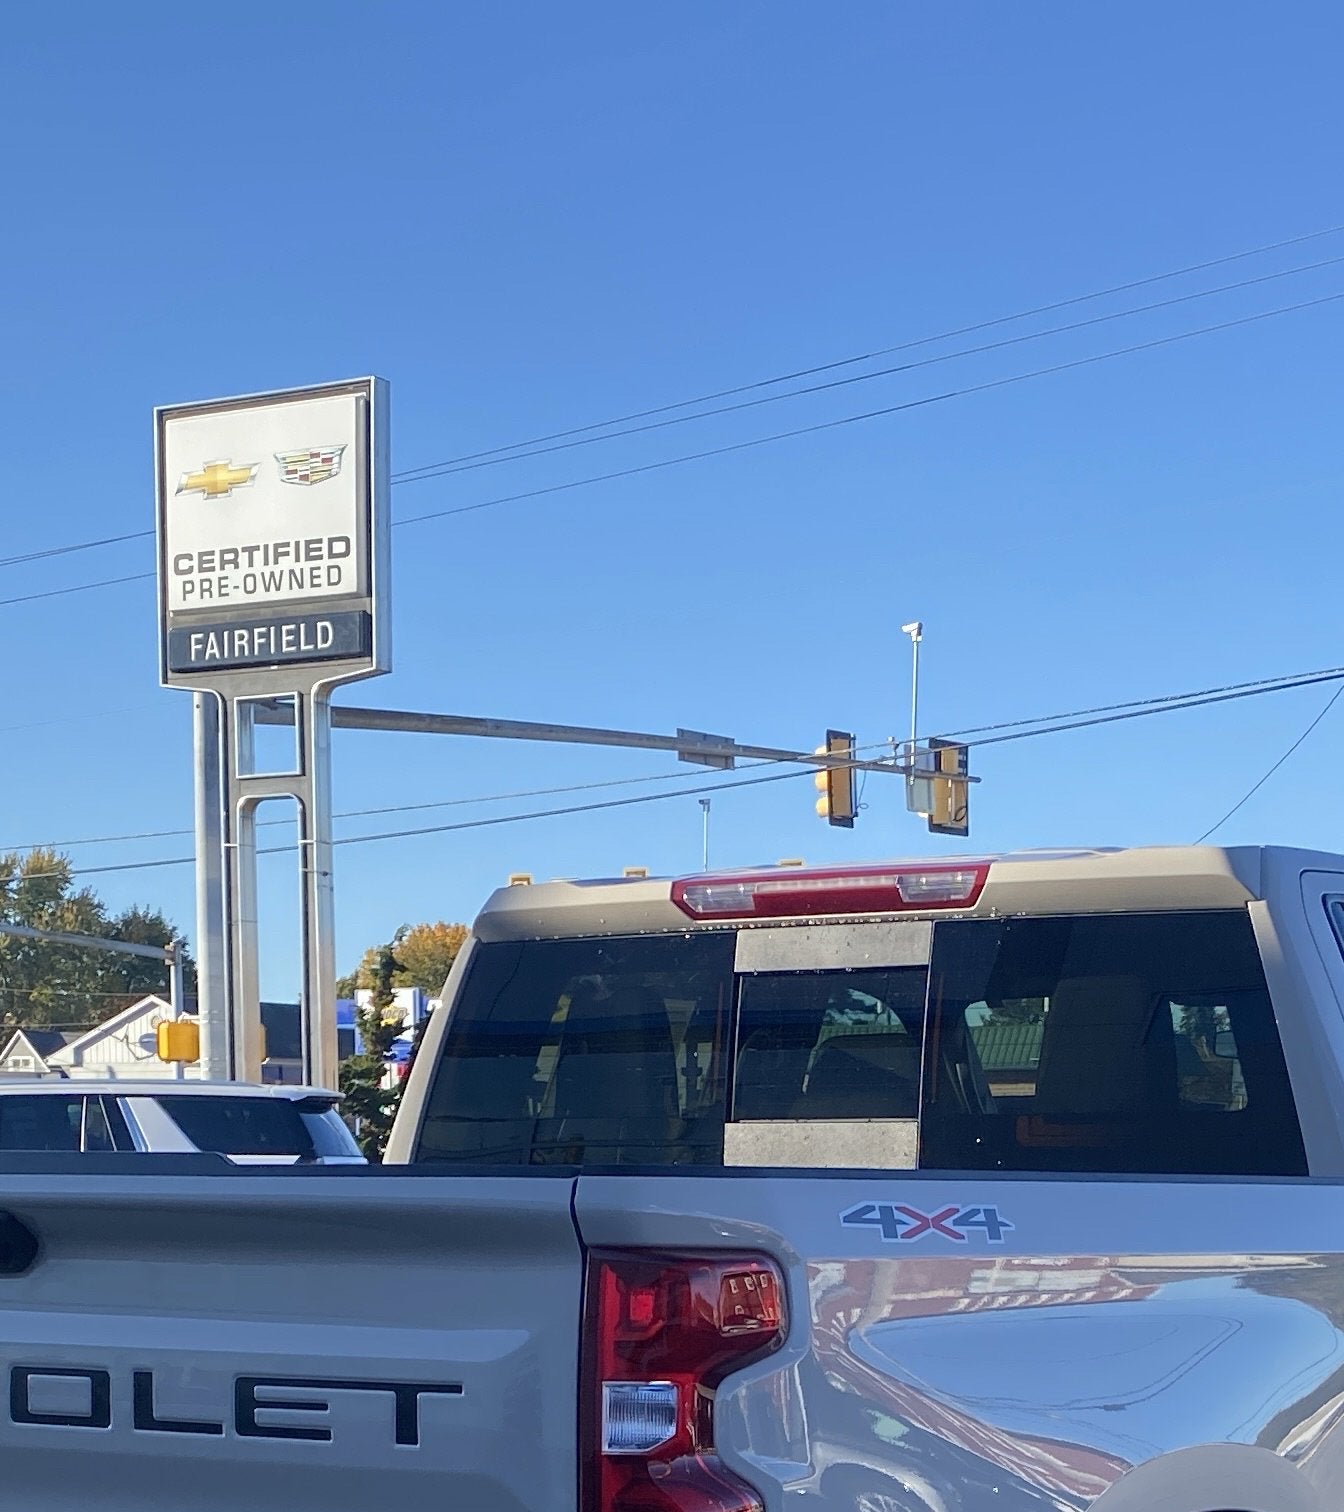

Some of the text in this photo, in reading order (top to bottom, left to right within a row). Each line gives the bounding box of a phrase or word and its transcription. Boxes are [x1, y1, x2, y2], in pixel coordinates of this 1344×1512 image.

[173, 535, 351, 576] CERTIFIED
[182, 564, 342, 601] PRE-OWNED
[190, 620, 334, 661] FAIRFIELD
